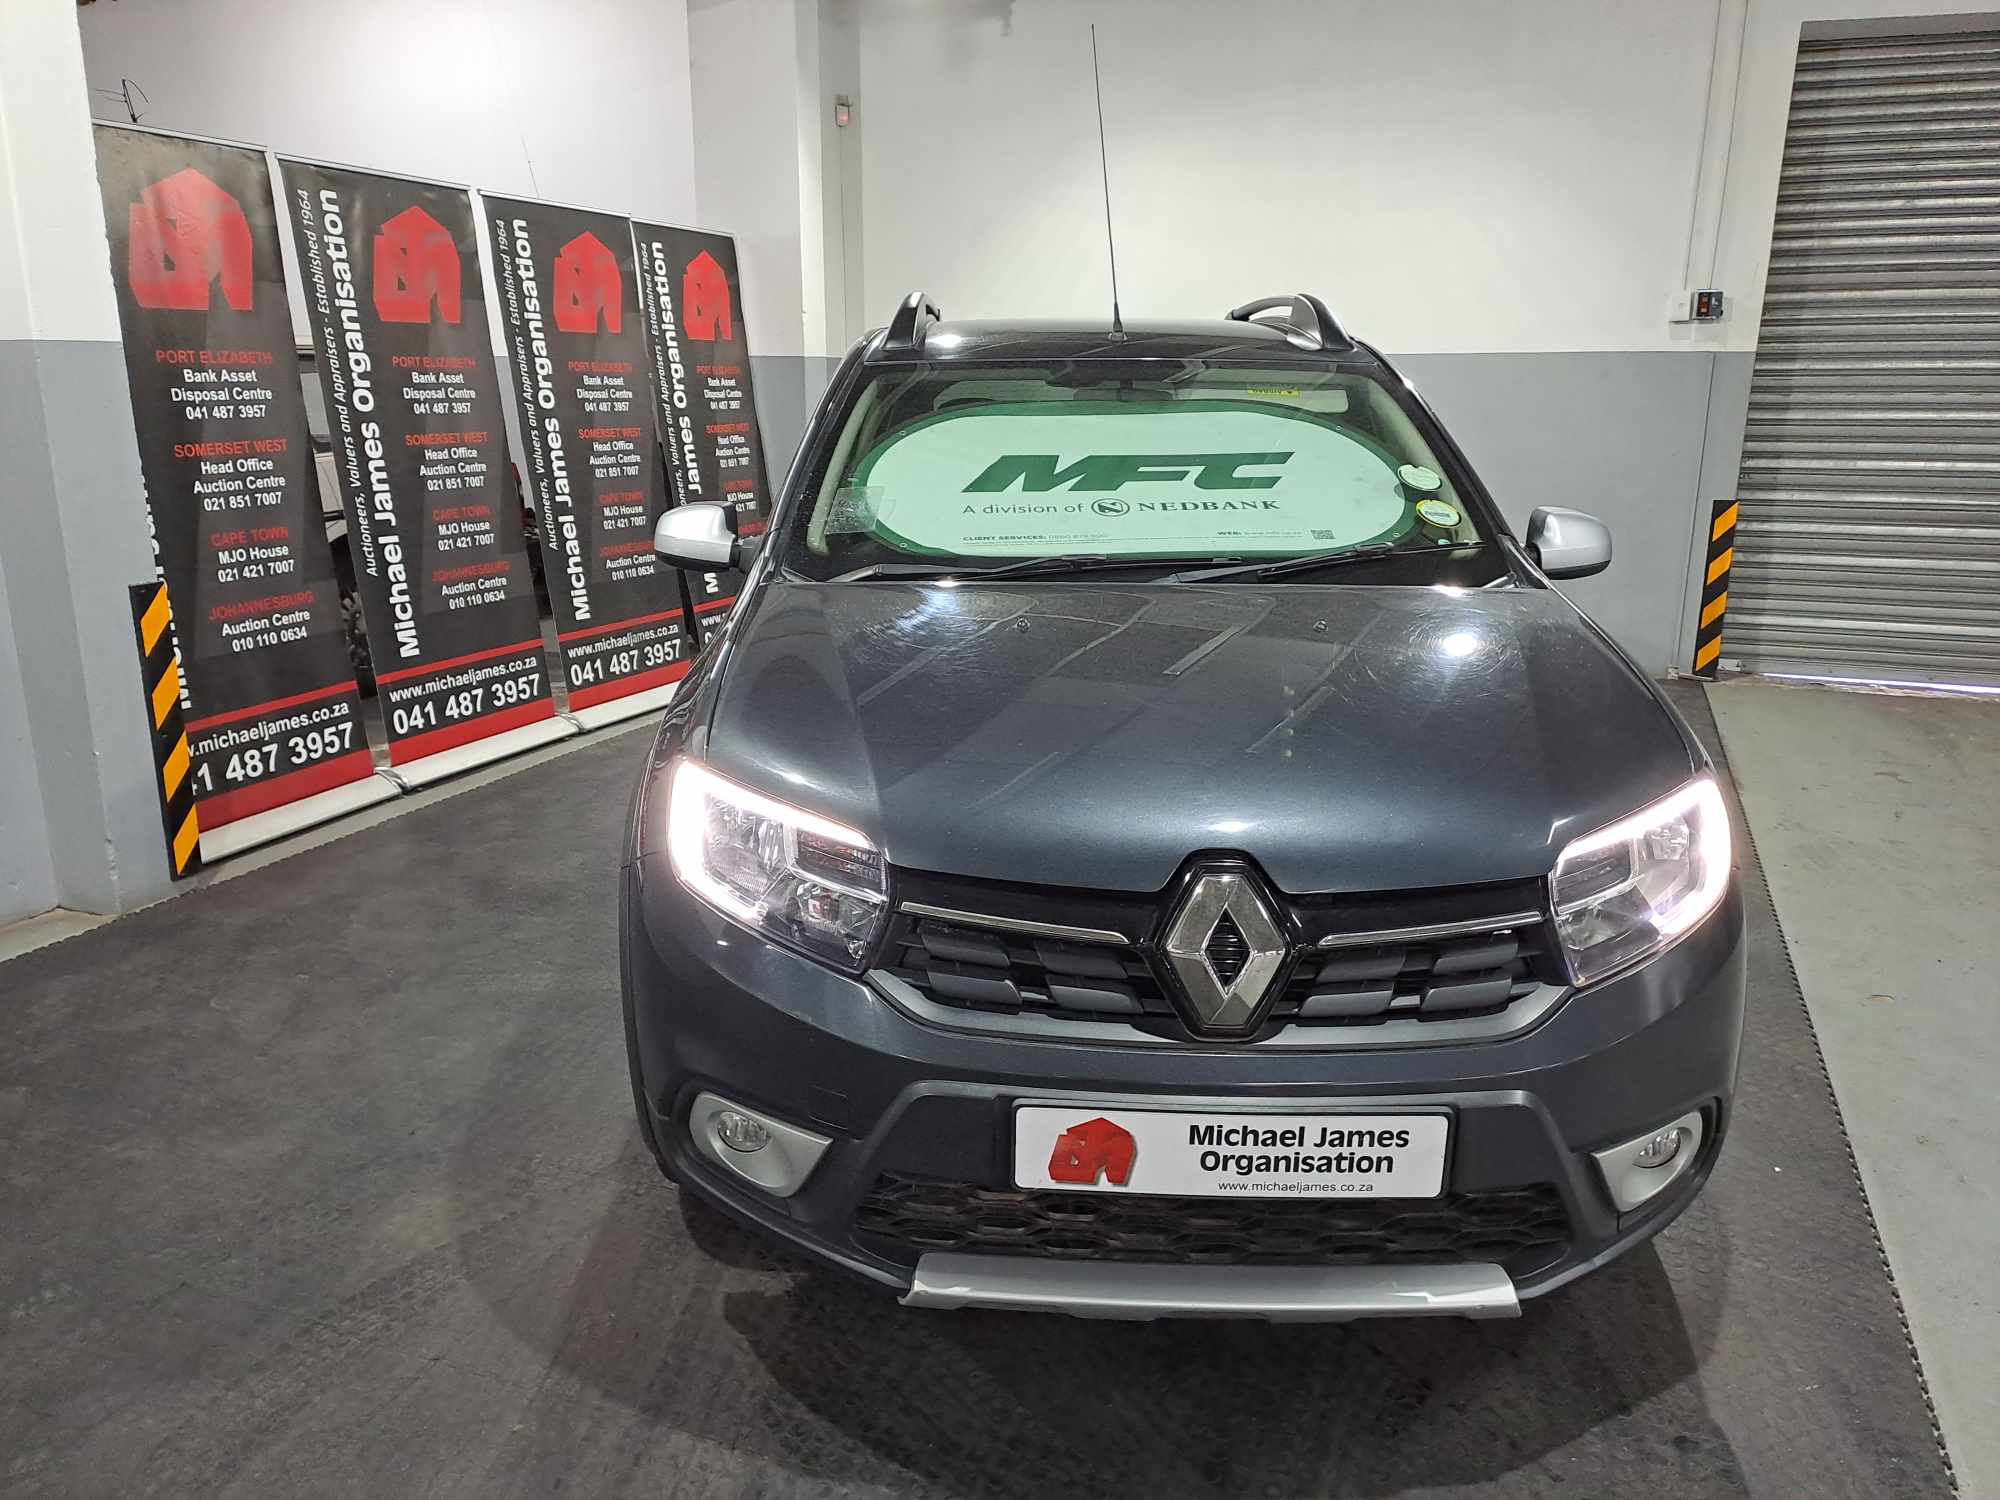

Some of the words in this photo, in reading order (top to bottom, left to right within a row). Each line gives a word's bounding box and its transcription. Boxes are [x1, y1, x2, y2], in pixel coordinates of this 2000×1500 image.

[296, 187, 314, 227] 1964
[495, 219, 509, 250] 1964
[302, 229, 331, 315] Established
[319, 188, 375, 413] Organisation
[500, 254, 521, 326] Established
[512, 218, 556, 411] Organisation
[643, 273, 660, 336] Established
[651, 241, 688, 410] Organisation
[155, 350, 196, 364] PORT
[200, 350, 273, 365] ELIZABETH
[322, 325, 348, 403] Appraisers
[392, 355, 420, 368] PORT
[514, 335, 535, 400] Appraisers
[183, 369, 218, 382] Bank
[220, 369, 258, 382] Asset
[411, 371, 437, 383] Bank
[438, 372, 465, 384] Asset
[582, 375, 602, 386] Bank
[603, 376, 625, 386] Asset
[654, 345, 670, 402] Appraisers
[171, 387, 230, 404] Disposal
[232, 387, 273, 400] Centre
[402, 387, 446, 401] Disposal
[447, 387, 476, 399] Centre
[576, 388, 609, 401] Disposal
[609, 388, 633, 399] Centre
[185, 406, 208, 420] 041
[212, 405, 235, 419] 487
[238, 405, 267, 418] 3957
[334, 404, 351, 433] and
[413, 403, 431, 415] 041
[433, 402, 449, 414] 487
[452, 402, 471, 414] 3957
[525, 403, 537, 427] and
[662, 403, 673, 425] and
[174, 441, 250, 458] SOMERSET
[254, 438, 288, 453] WEST
[404, 433, 460, 446] SOMERSET
[592, 441, 611, 452] Head
[612, 440, 634, 451] Office
[667, 426, 680, 466] Valuers
[343, 435, 362, 488] Valuers
[424, 447, 449, 460] Head
[450, 446, 478, 459] Office
[531, 430, 546, 475] Valuers
[544, 416, 573, 508] James
[589, 455, 617, 465] Auction
[617, 453, 641, 463] Centre
[678, 415, 702, 495] James
[200, 459, 235, 475] Head
[236, 458, 274, 472] Office
[360, 421, 397, 527] James
[419, 463, 456, 476] Auction
[457, 461, 487, 473] Centre
[594, 468, 608, 478] 021
[960, 451, 1296, 493] MFC
[193, 478, 243, 494] Auction
[246, 475, 286, 489] Centre
[427, 479, 444, 491] 021
[445, 478, 462, 490] 851
[464, 476, 485, 488] 7007
[203, 497, 226, 512] 021
[229, 494, 252, 509] 851
[254, 491, 282, 506] 7007
[603, 506, 620, 516] MJO
[620, 504, 643, 514] House
[962, 504, 977, 515] A
[982, 503, 1057, 514] division
[1064, 503, 1084, 514] of
[1138, 500, 1281, 512] NEDBANK
[539, 477, 559, 551] Auctioneers,
[603, 519, 616, 530] 021
[616, 518, 629, 528] 421
[630, 516, 647, 526] 7007
[354, 493, 379, 577] Auctioneers,
[438, 522, 459, 536] MJO
[460, 521, 490, 533] House
[437, 538, 454, 551] 021
[456, 536, 472, 548] 421
[474, 533, 495, 546] 7007
[218, 548, 246, 565] MJO
[249, 545, 289, 560] House
[606, 557, 632, 569] Auction
[632, 553, 656, 564] Centre
[217, 567, 239, 583] 021
[242, 563, 264, 578] 421
[267, 559, 295, 575] 7007
[557, 514, 592, 621] Michael
[377, 534, 421, 659] Michael
[441, 581, 476, 596] Auction
[477, 576, 507, 589] Centre
[448, 597, 465, 610] 010
[466, 593, 482, 606] 110
[484, 590, 506, 603] 0634
[222, 618, 270, 637] Auction
[272, 610, 311, 626] Centre
[232, 636, 254, 653] 010
[256, 631, 278, 647] 110
[280, 625, 308, 643] 0634
[567, 624, 679, 658] www.michaeljames.co.za
[570, 658, 604, 686] 041
[609, 649, 639, 675] 487
[643, 638, 681, 666] 3957
[388, 656, 537, 703] www.michaeljames.co.za
[392, 700, 437, 735] 041
[444, 688, 484, 719] 487
[490, 673, 540, 708] 3957
[225, 742, 279, 783] 487
[287, 721, 353, 765] 3957
[1188, 1124, 1306, 1148] Michael
[1313, 1126, 1411, 1149] James
[1199, 1150, 1395, 1177] Organisation
[1217, 1181, 1374, 1194] www.michaeljames.co.za
